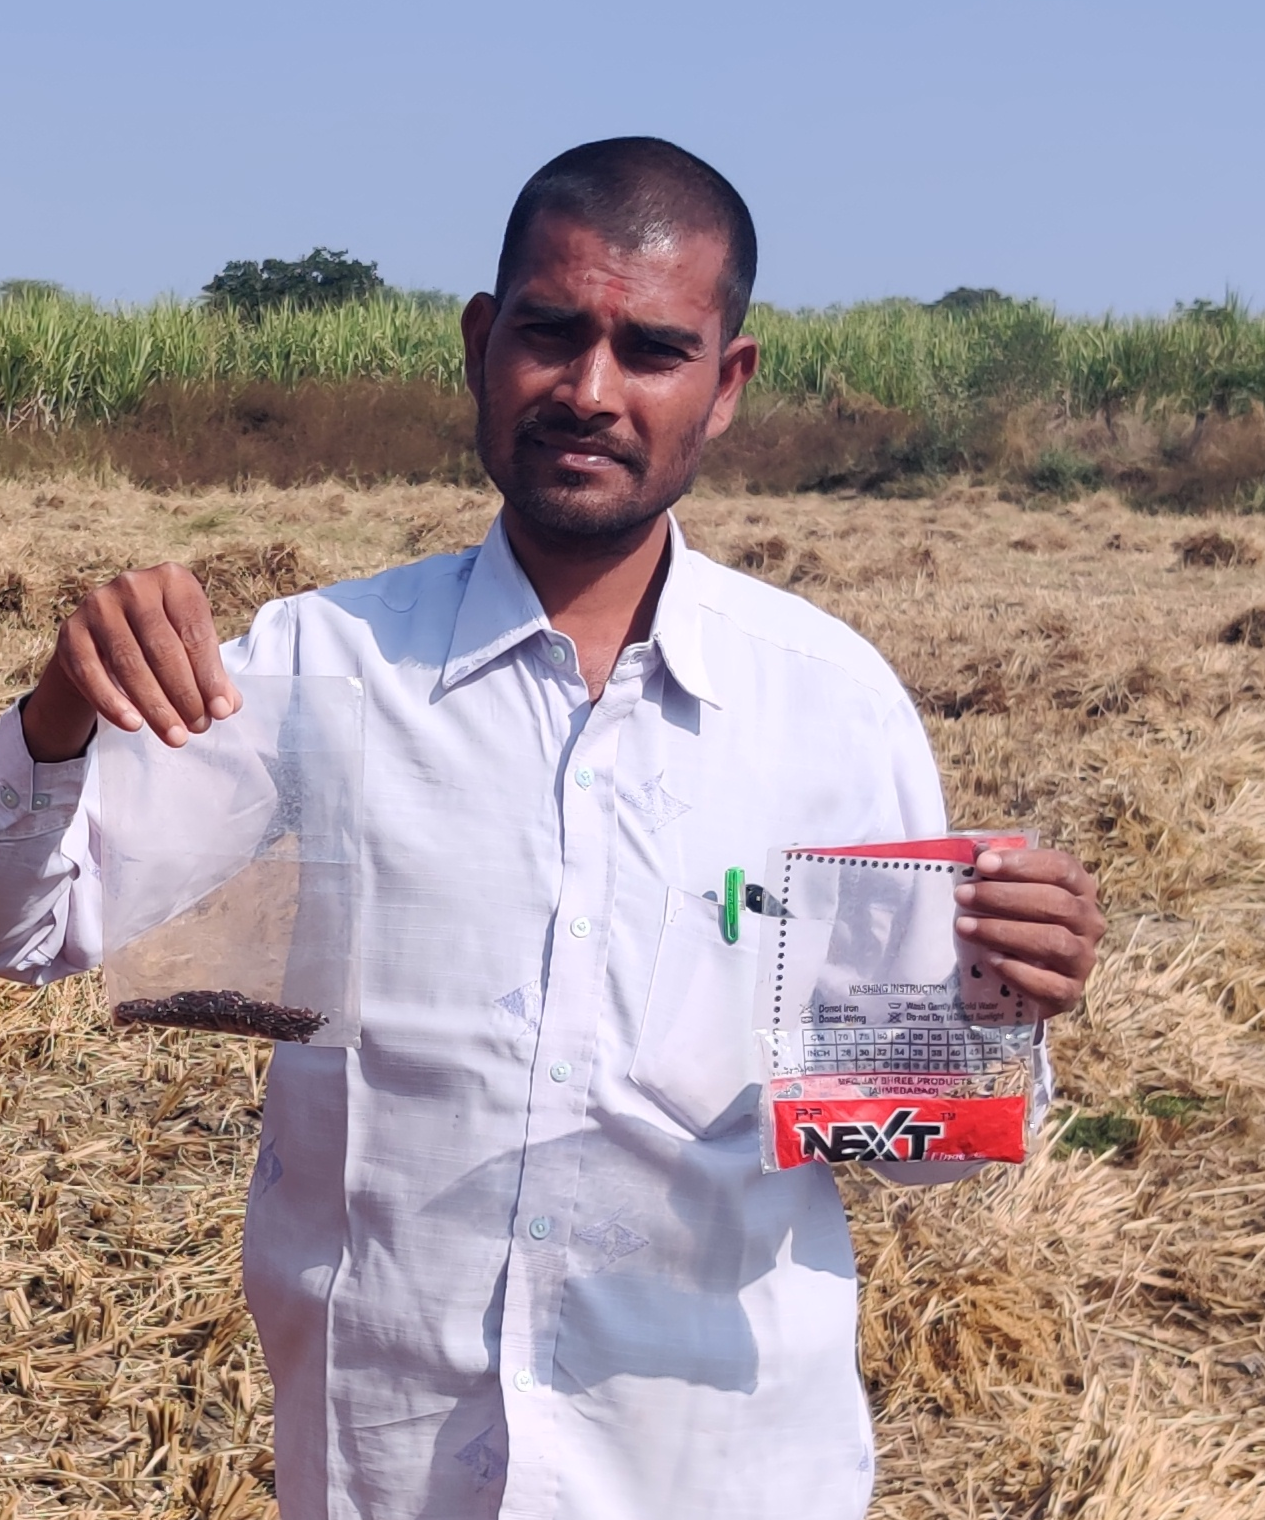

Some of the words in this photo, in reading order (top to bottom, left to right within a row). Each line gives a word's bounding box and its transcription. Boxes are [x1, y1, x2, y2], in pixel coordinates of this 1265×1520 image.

[849, 984, 888, 995] WASHING
[890, 984, 947, 994] INSTRUCTION
[906, 1002, 925, 1011] Wash
[927, 1002, 951, 1012] Gently
[960, 1002, 976, 1010] Cold
[978, 1002, 999, 1010] Water
[932, 1013, 944, 1023] Dry
[976, 1012, 1004, 1022] Sunlight
[858, 1033, 870, 1041] 75
[841, 1049, 852, 1057] 28
[859, 1049, 870, 1057] 30
[877, 1048, 887, 1057] 32
[894, 1048, 905, 1056] 34
[862, 1076, 878, 1085] JAY
[917, 1077, 973, 1086] PRODUCTS
[794, 1107, 945, 1162] NEXT
